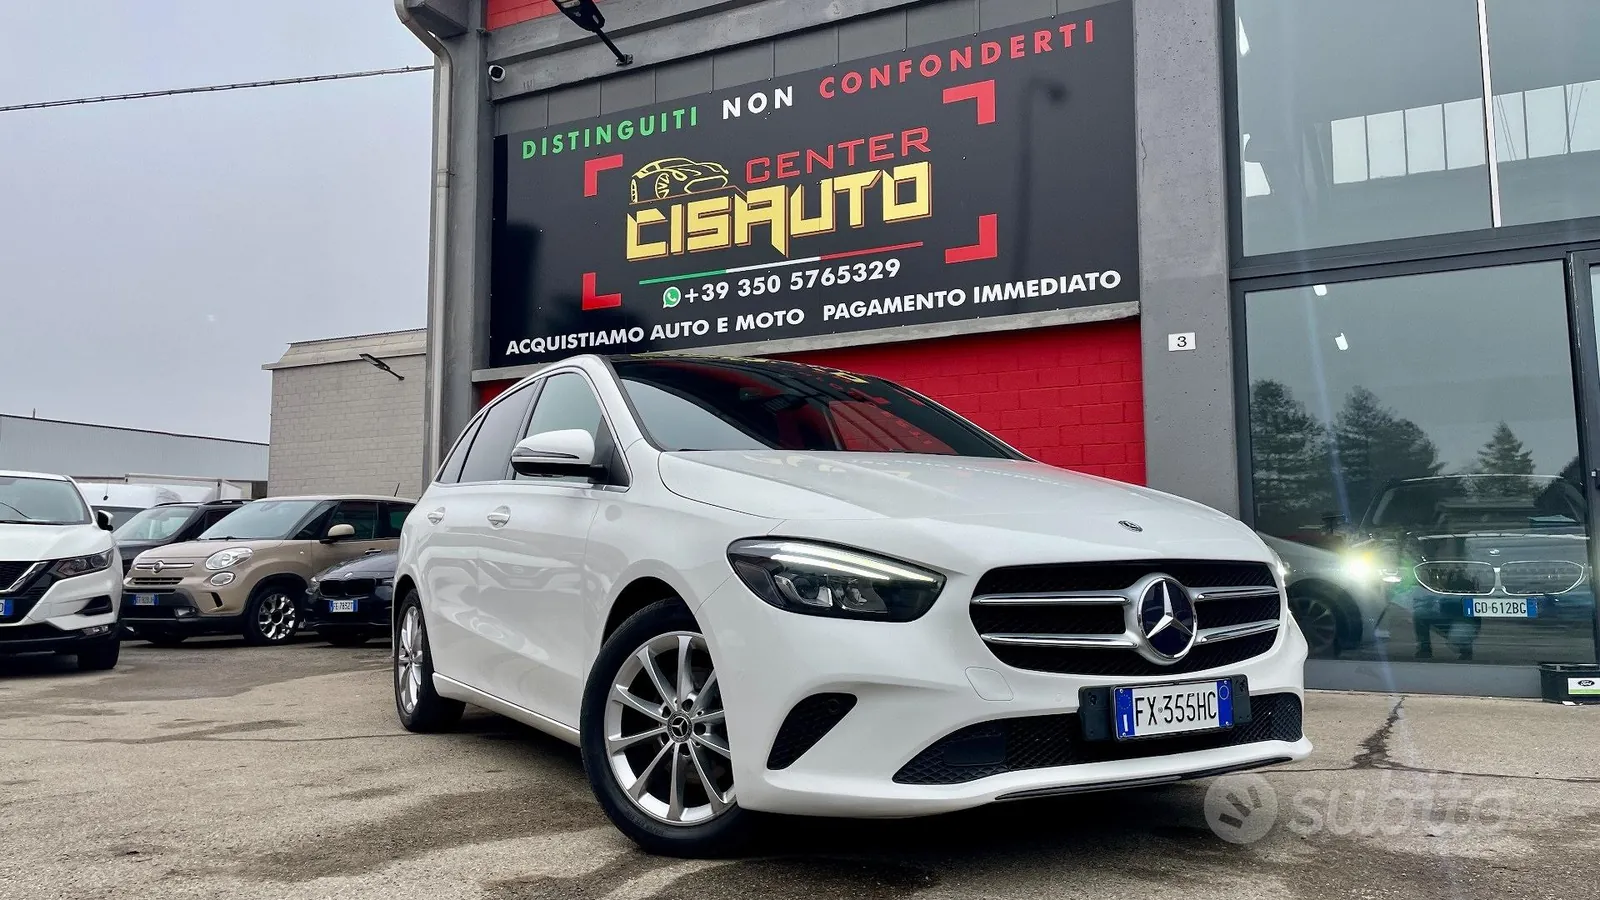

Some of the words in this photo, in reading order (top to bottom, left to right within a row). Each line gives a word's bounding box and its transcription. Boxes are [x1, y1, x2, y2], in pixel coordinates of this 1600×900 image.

[522, 107, 698, 159] DISTINGUITI
[722, 86, 793, 120] NON
[819, 19, 1094, 99] CONFONDERTI
[745, 127, 931, 183] CENTER
[626, 161, 932, 262] CISAUTO
[505, 327, 645, 356] ACQUISTIAMO
[650, 318, 710, 341] AUTO
[717, 316, 729, 333] E
[735, 308, 805, 331] MOTO
[823, 288, 966, 322] PAGAMENTO
[973, 270, 1121, 304] IMMEDIATO
[684, 281, 729, 303] +39
[737, 274, 781, 297] 350
[790, 258, 901, 291] 5765329
[1177, 336, 1187, 348] 3
